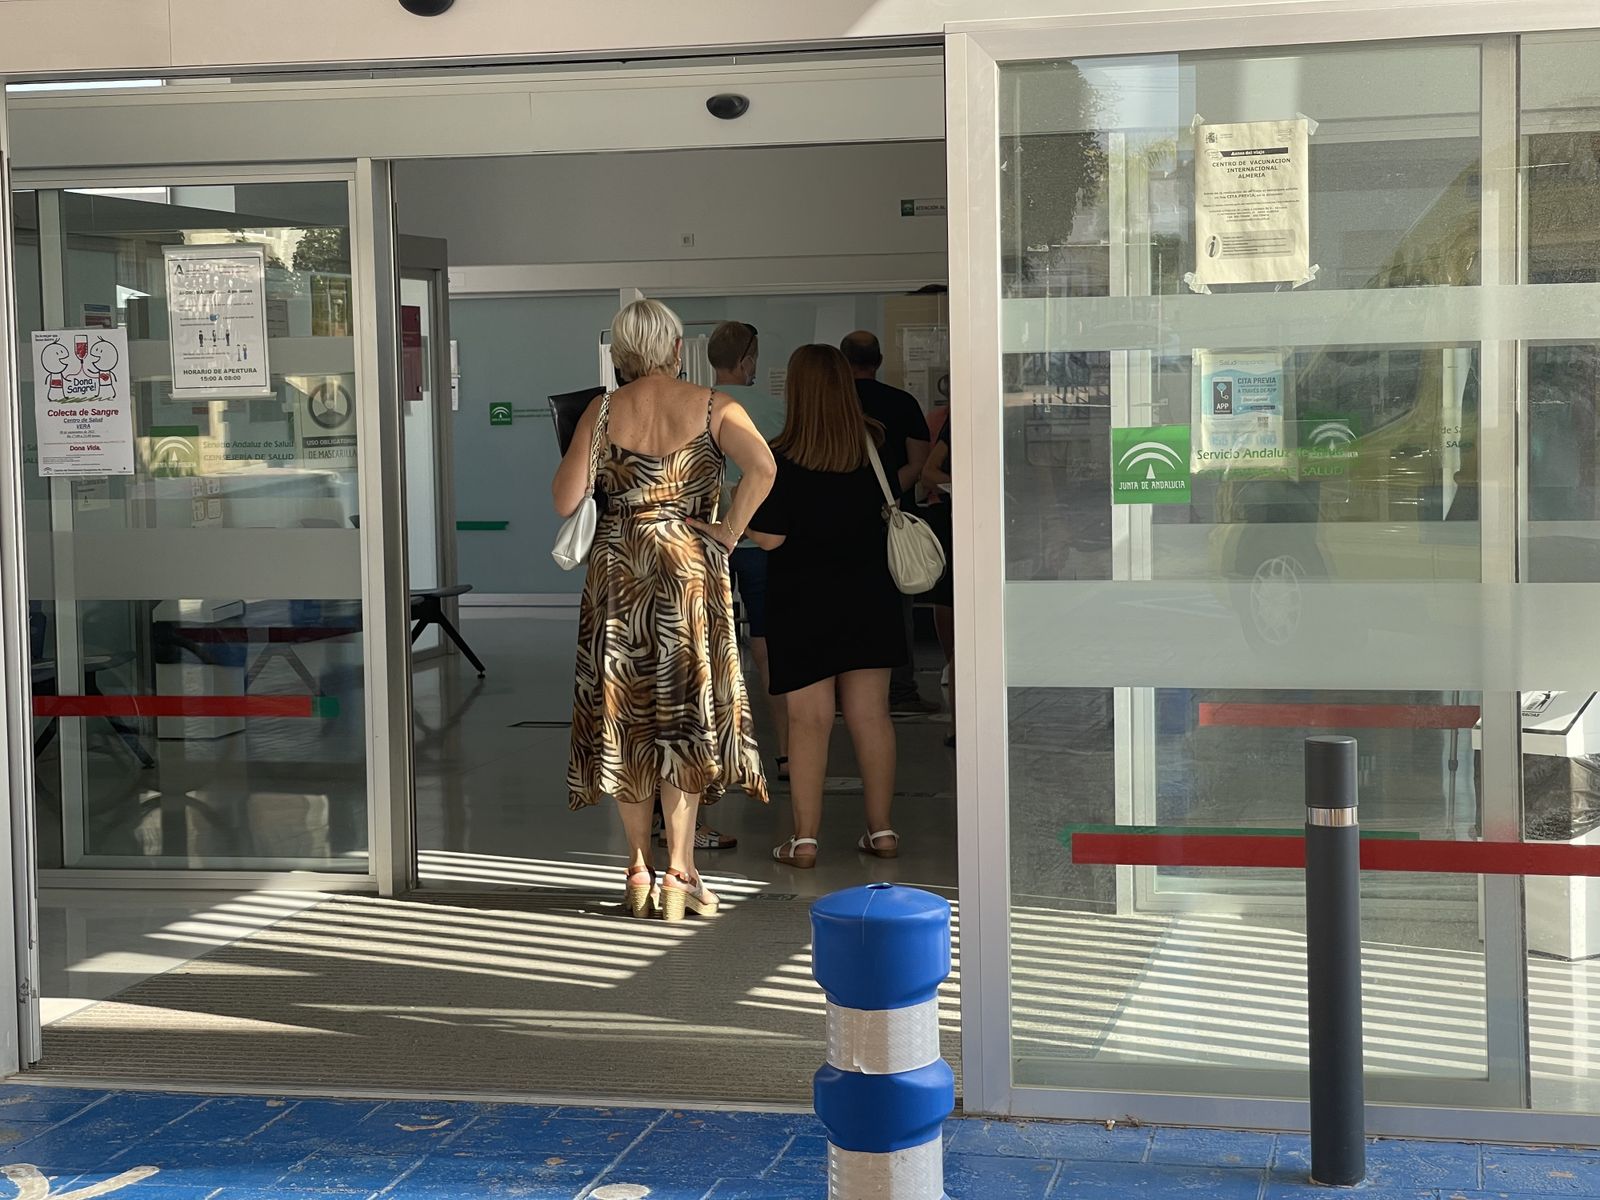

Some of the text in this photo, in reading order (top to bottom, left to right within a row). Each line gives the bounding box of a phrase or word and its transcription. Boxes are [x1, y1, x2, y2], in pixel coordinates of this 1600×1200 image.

[1227, 165, 1278, 173] INTERNACIONAL
[73, 378, 93, 386] Dona
[67, 382, 97, 395] Sangre!
[47, 409, 77, 417] Colecta
[91, 408, 119, 417] Sangre
[231, 440, 261, 448] Andaluz
[263, 440, 273, 448] de
[274, 440, 294, 448] Salud
[308, 450, 318, 459] DE
[1197, 448, 1240, 460] Servicio
[1302, 466, 1344, 477] SALUD
[1118, 480, 1186, 490] JUNTA DE ANDALUCIA
